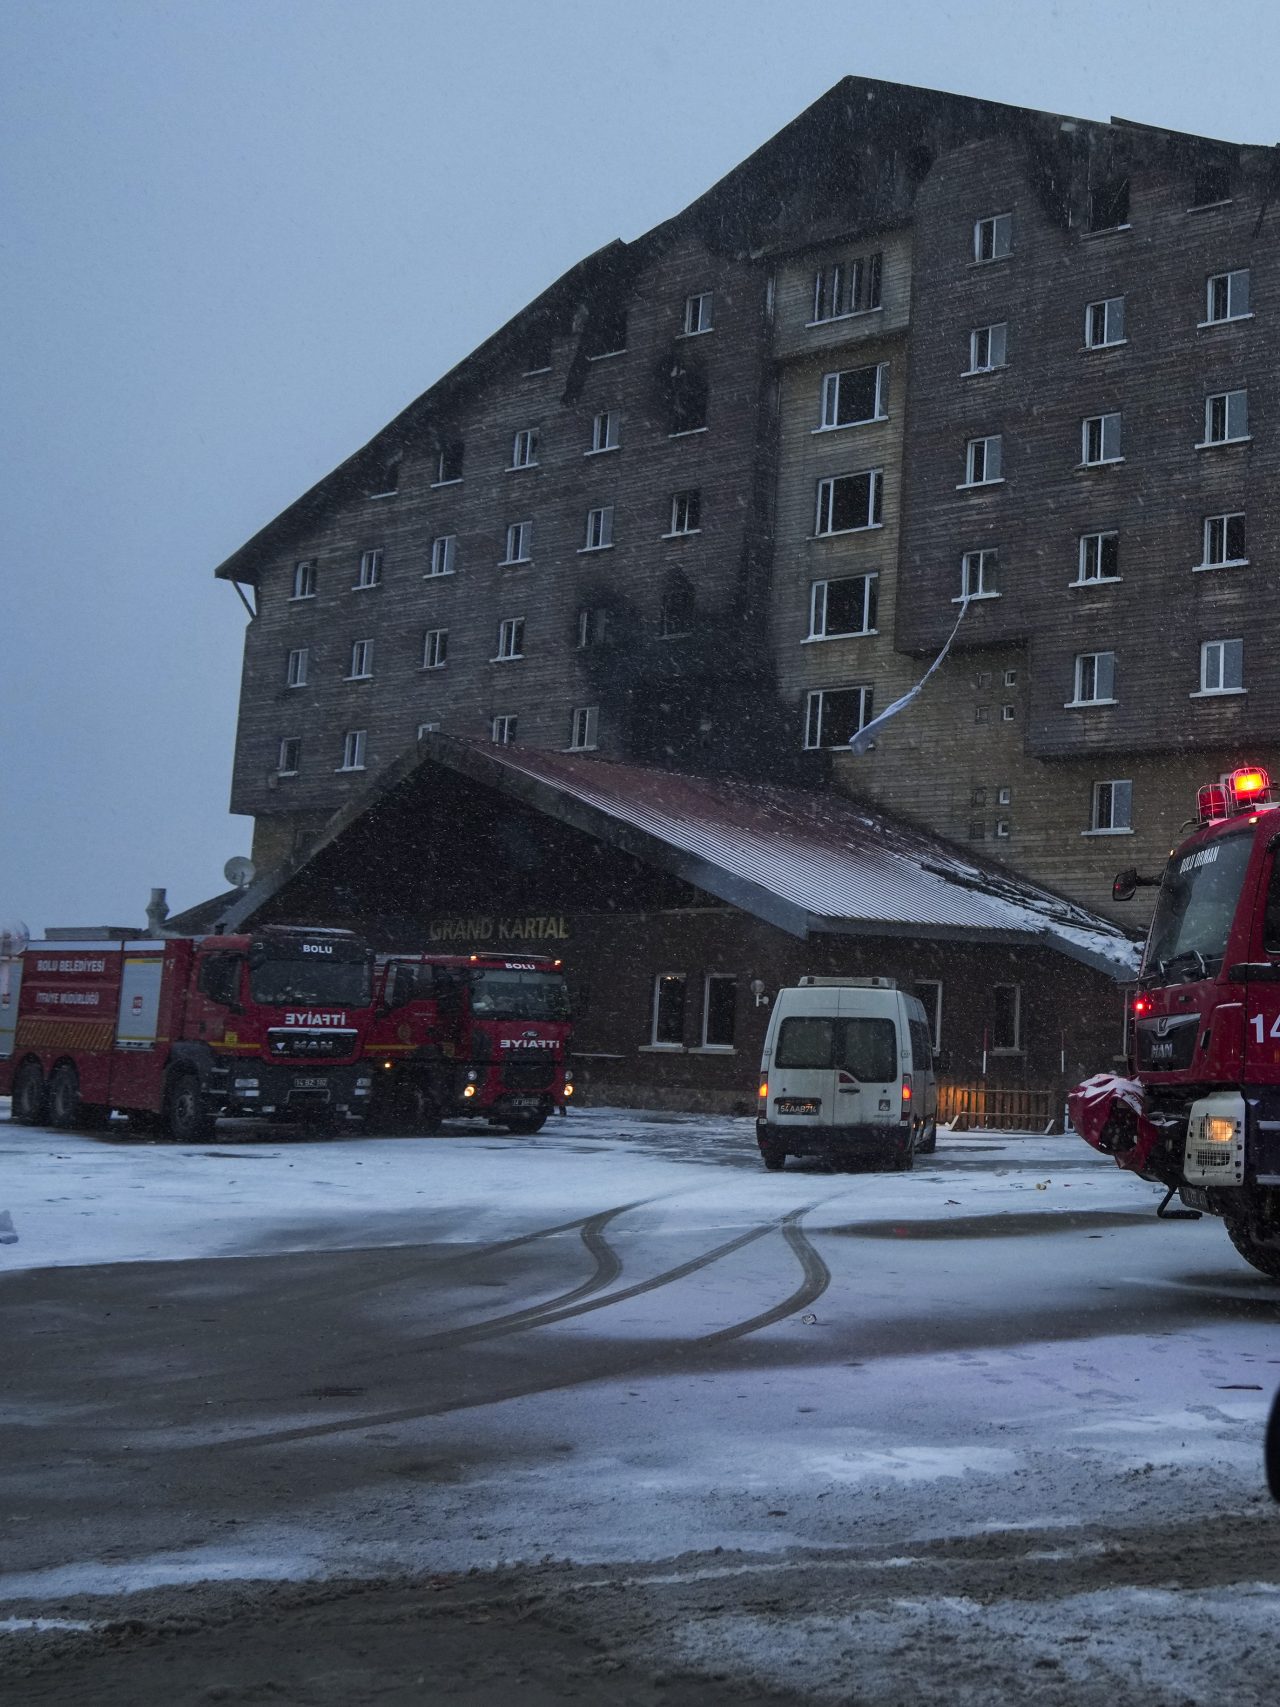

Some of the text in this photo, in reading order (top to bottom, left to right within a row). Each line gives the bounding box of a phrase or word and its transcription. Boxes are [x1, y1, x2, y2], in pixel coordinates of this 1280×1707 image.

[1194, 846, 1220, 868] ORMAN
[430, 916, 569, 941] GRAND KARTAL
[303, 944, 333, 954] BOLU
[37, 958, 105, 973] BOLU BELEDİYESİ
[505, 962, 536, 970] BOLU
